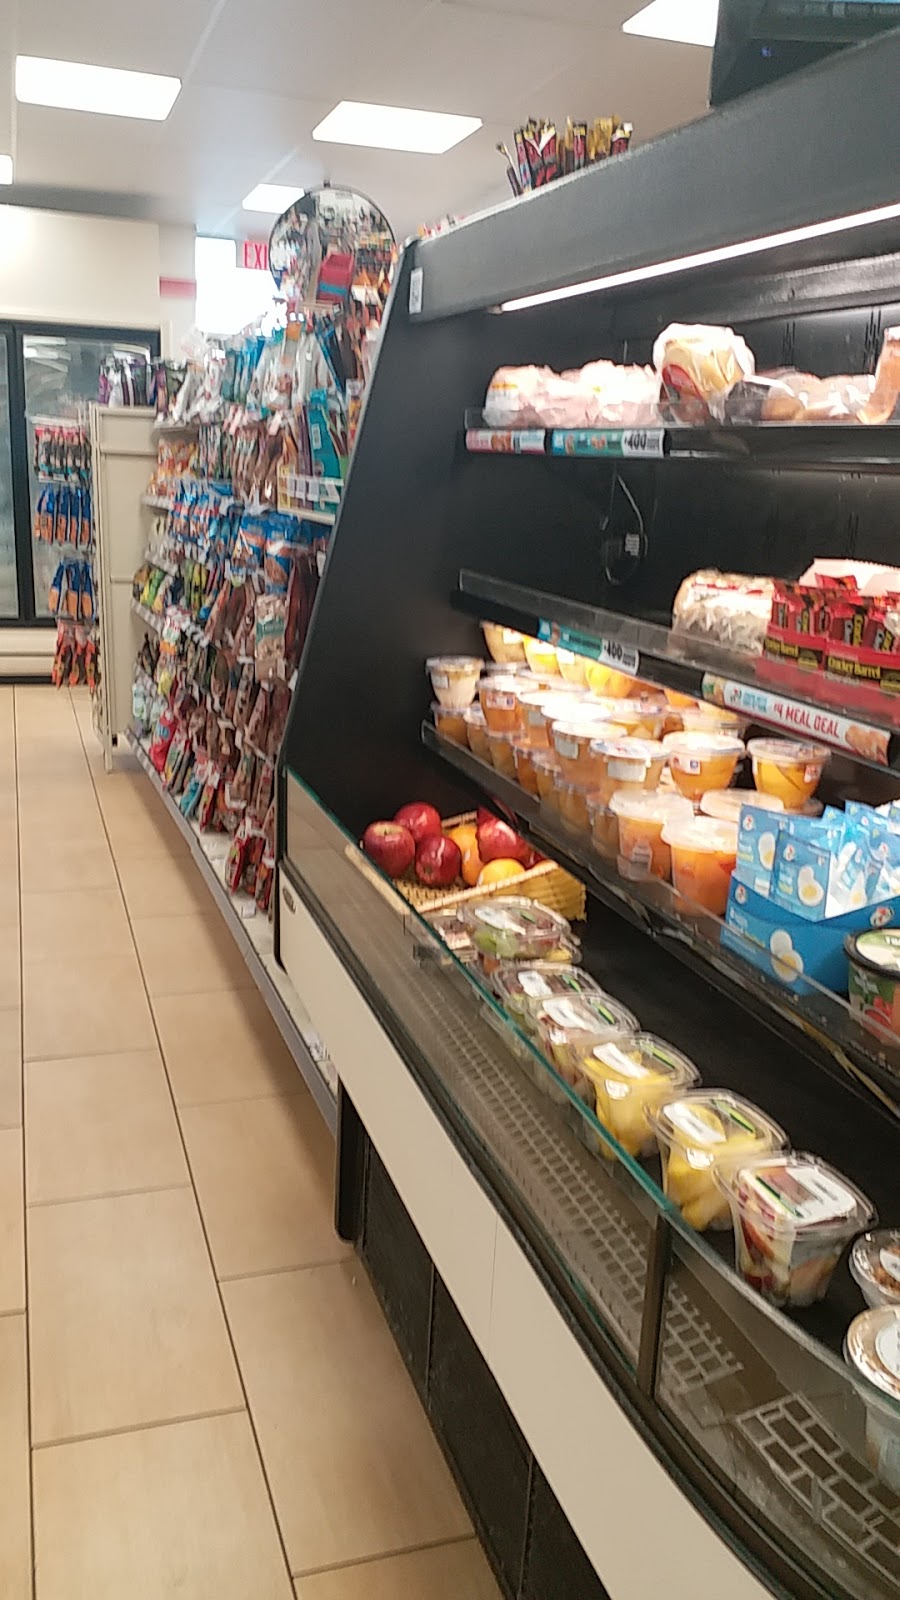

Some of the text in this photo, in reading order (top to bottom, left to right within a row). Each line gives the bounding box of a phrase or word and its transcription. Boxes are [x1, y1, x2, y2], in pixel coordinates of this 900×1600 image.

[244, 242, 268, 270] EXI
[785, 705, 812, 729] MEAL
[813, 714, 840, 739] DEAL
